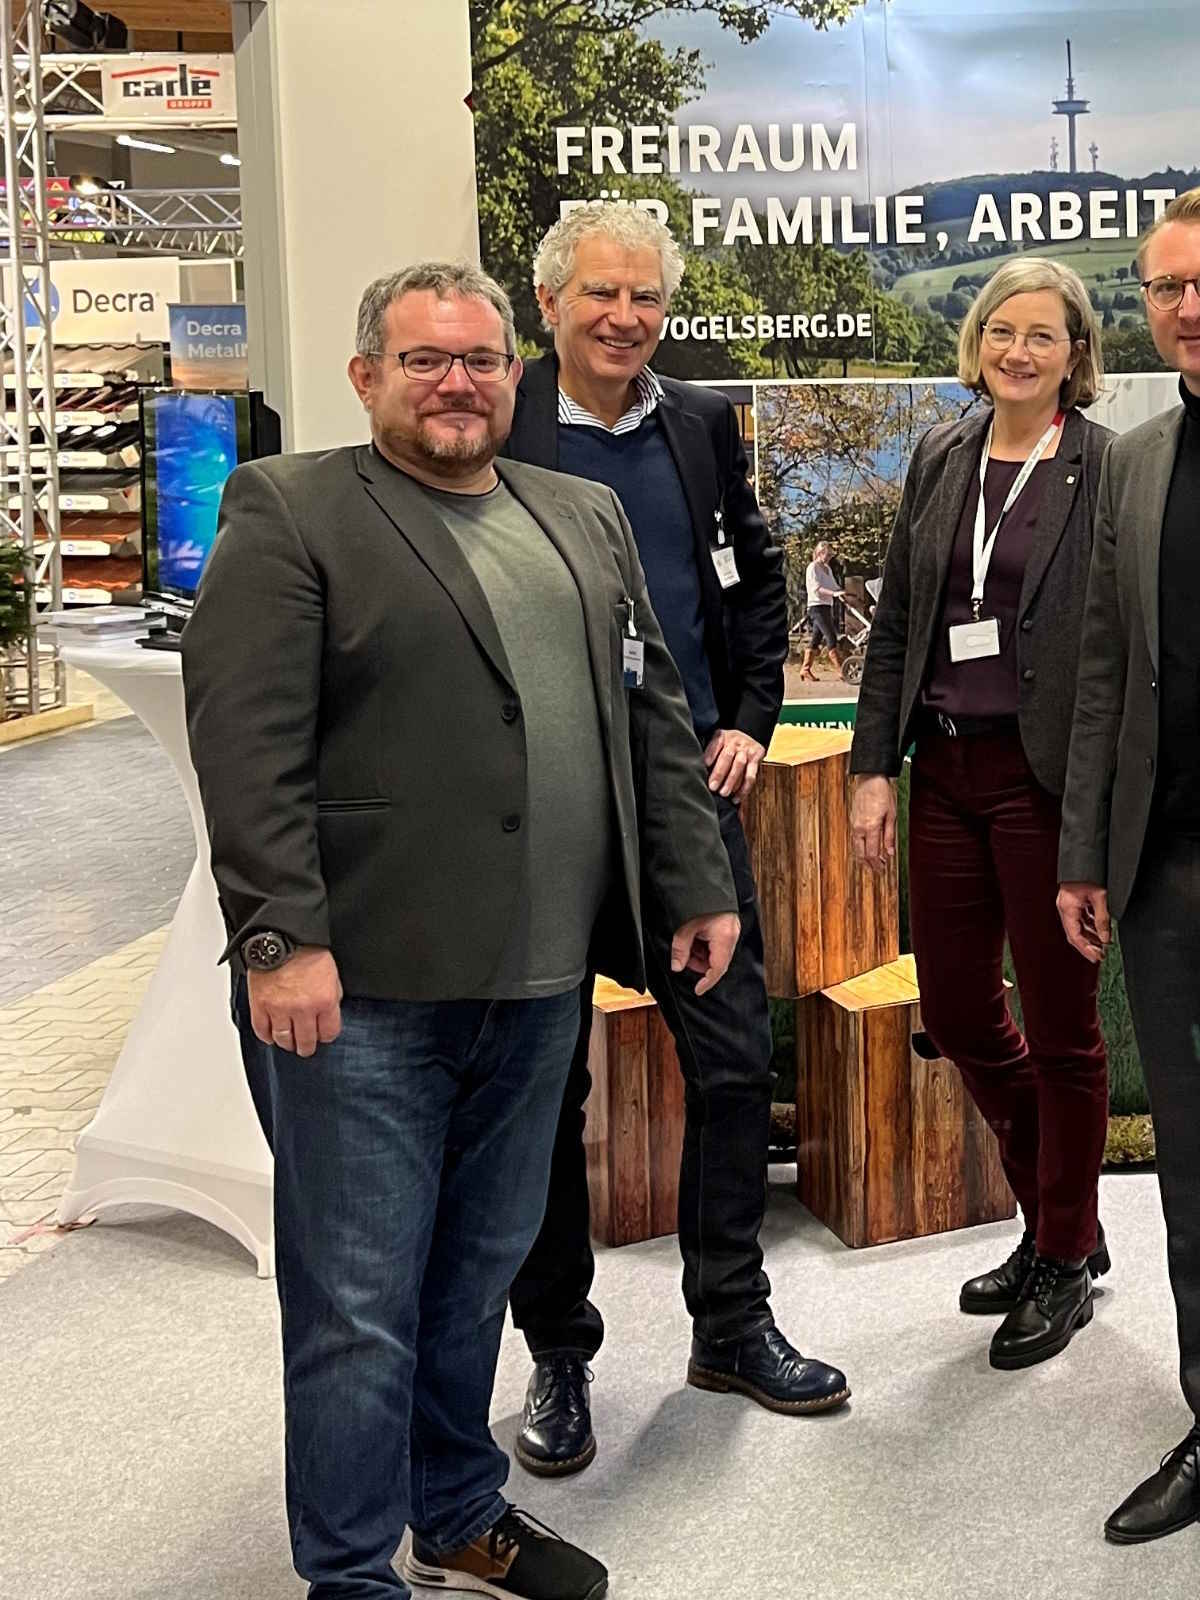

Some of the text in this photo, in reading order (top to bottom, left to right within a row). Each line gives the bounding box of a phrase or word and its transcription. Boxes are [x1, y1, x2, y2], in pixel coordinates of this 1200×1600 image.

[556, 123, 857, 175] FREIRAUM
[692, 195, 948, 251] FAMILIE,
[967, 188, 1176, 241] ARBEIT
[73, 289, 155, 313] Decra
[187, 320, 241, 336] Decra
[188, 343, 248, 358] Metall
